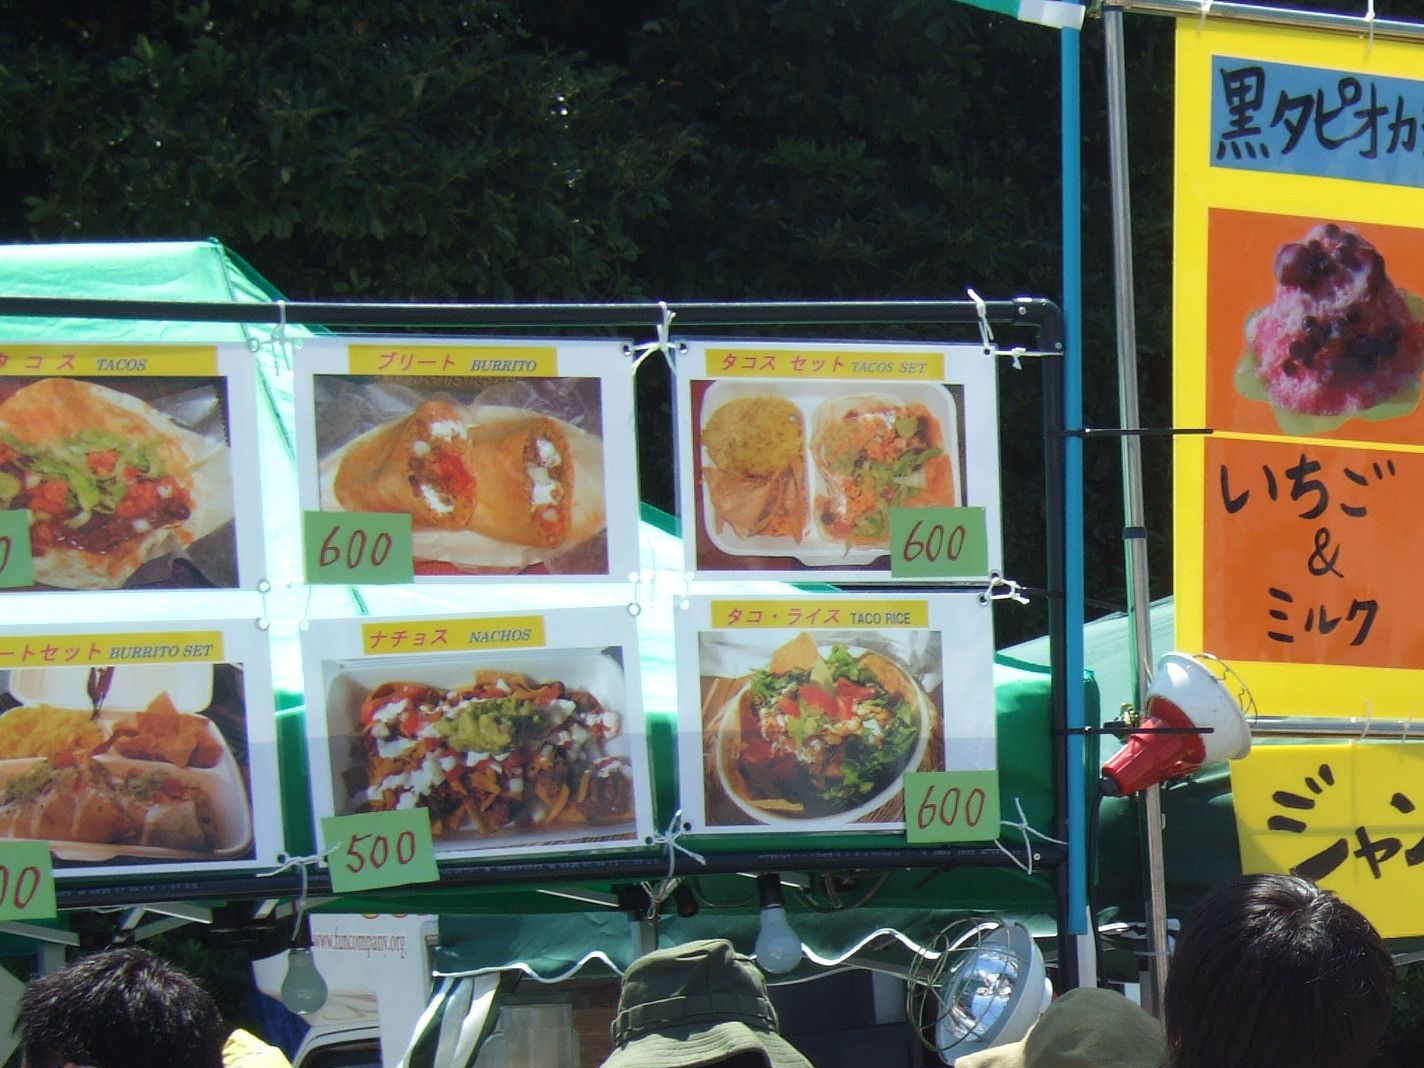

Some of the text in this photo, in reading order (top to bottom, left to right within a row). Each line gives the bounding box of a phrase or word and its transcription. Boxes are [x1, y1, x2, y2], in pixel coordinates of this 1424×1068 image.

[96, 358, 148, 371] TACOS
[470, 359, 538, 373] BURRITO
[722, 353, 928, 374] タコス セット TACOS SET
[1219, 453, 1397, 520] いちご
[318, 526, 394, 570] 600
[904, 520, 966, 563] 600
[1308, 526, 1345, 579] &
[370, 628, 532, 648] ナチョス NACHOS
[850, 612, 881, 625] TACO
[885, 612, 911, 625] RICE
[1266, 587, 1380, 646] ミルク
[109, 644, 180, 660] BURRITO
[182, 643, 214, 657] SET
[917, 784, 987, 830] 600
[346, 830, 416, 874] 500
